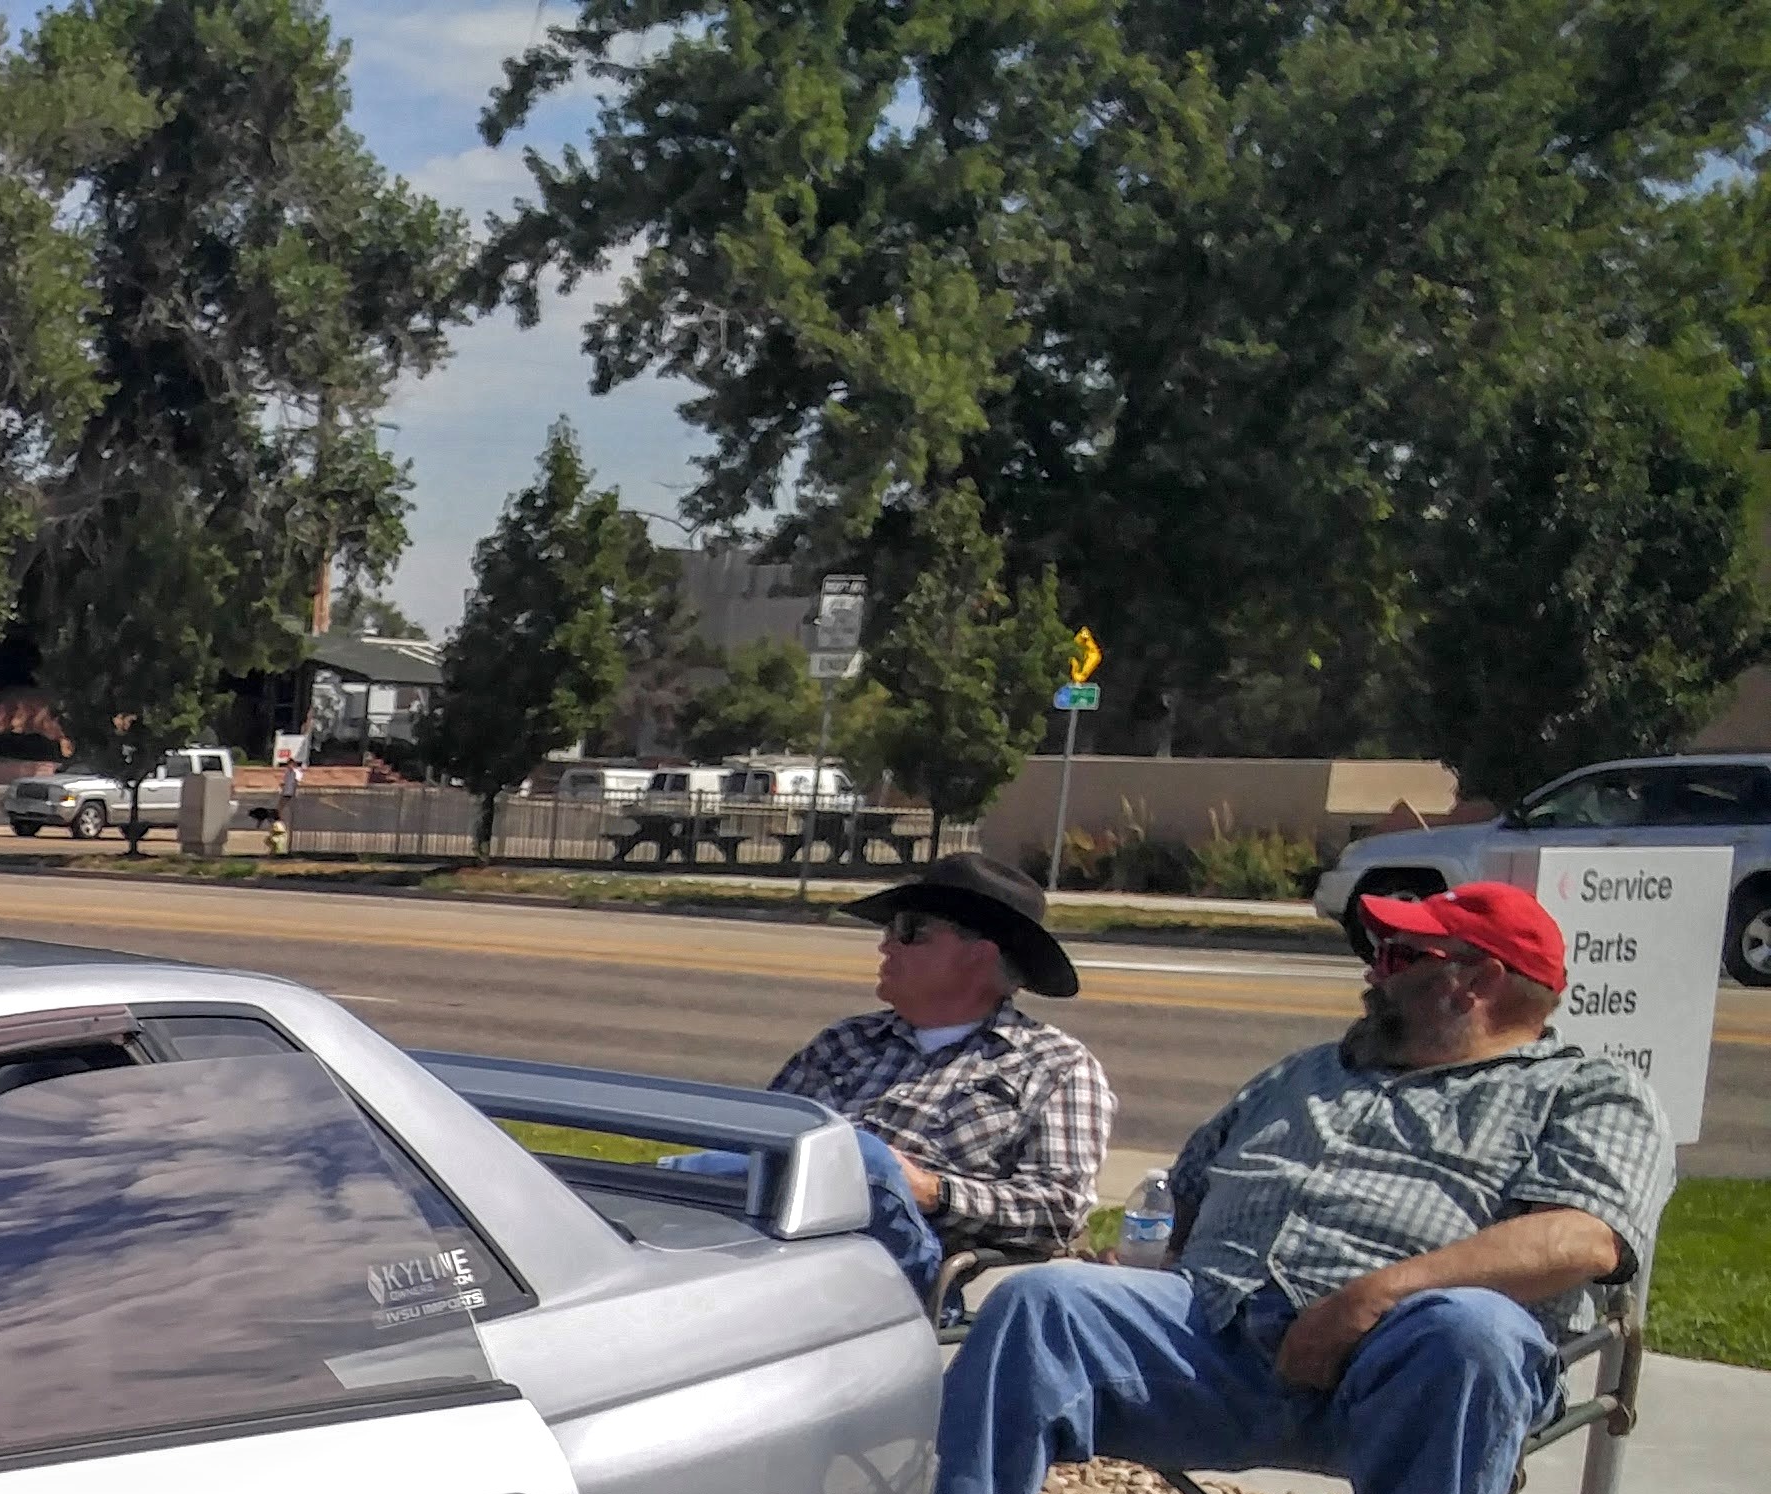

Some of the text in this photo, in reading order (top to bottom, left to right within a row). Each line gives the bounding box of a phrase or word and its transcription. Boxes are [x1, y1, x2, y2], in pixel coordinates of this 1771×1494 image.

[1581, 868, 1673, 903] Service
[1573, 931, 1638, 964] Parts
[1568, 982, 1637, 1016] Sales
